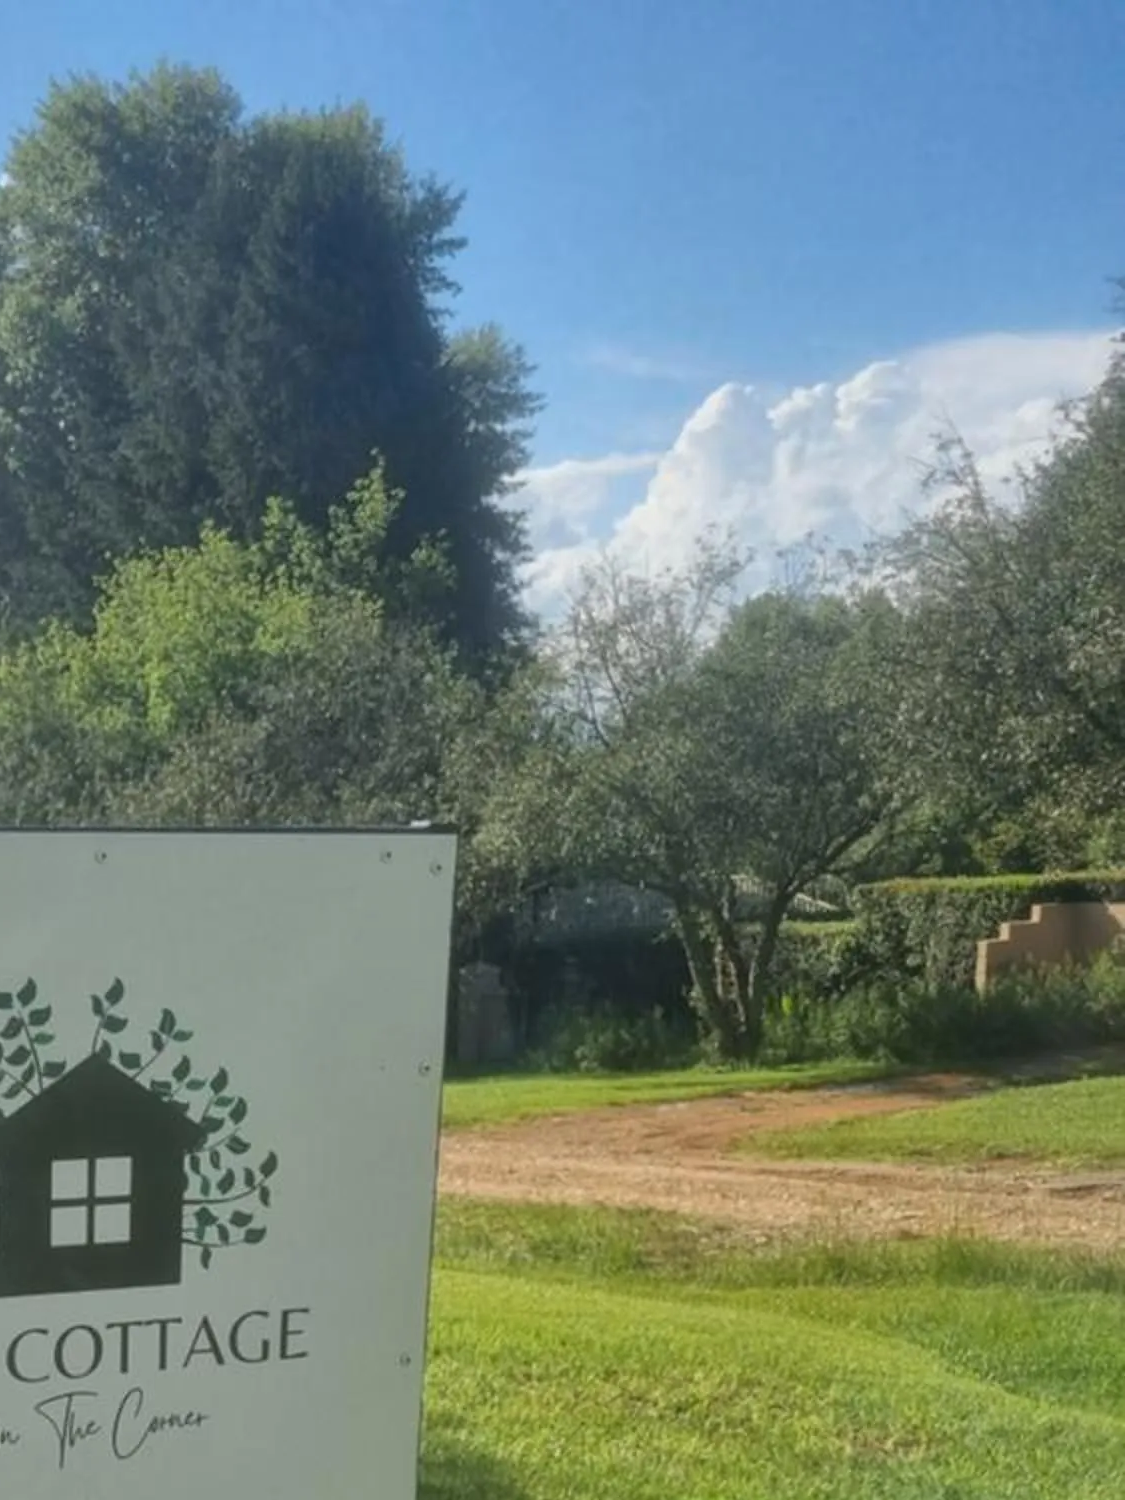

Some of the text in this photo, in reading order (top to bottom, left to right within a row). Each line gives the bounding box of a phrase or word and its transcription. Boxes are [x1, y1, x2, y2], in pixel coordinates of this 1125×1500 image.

[6, 1308, 310, 1384] COTTAGE
[35, 1391, 101, 1469] The
[112, 1387, 210, 1460] Corner
